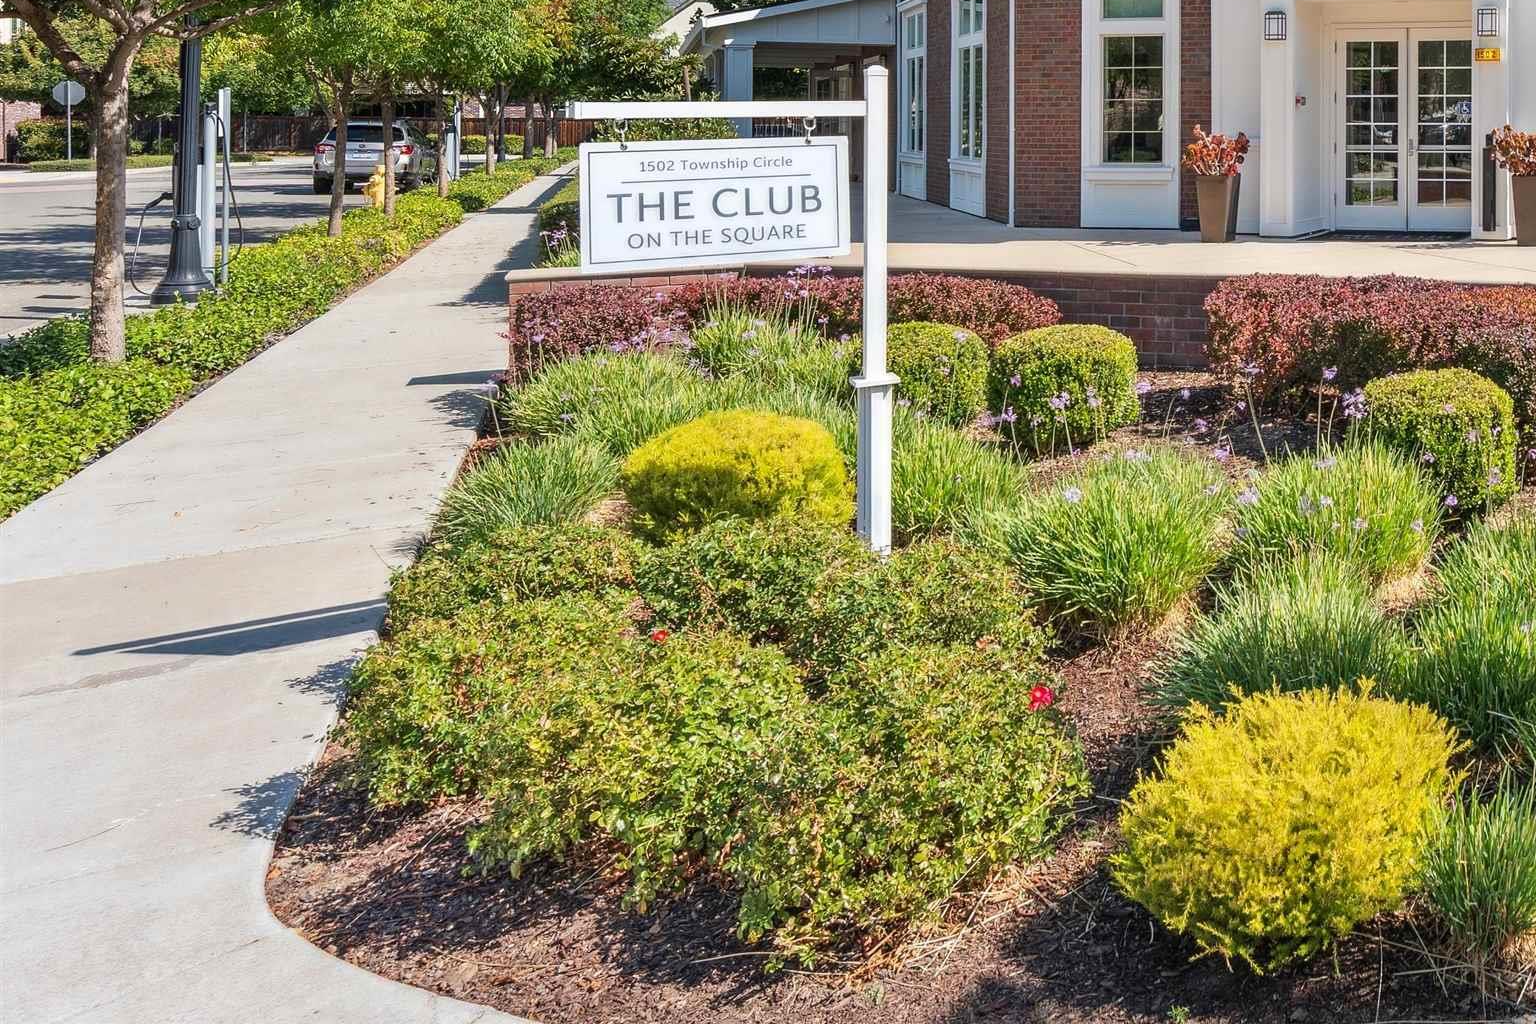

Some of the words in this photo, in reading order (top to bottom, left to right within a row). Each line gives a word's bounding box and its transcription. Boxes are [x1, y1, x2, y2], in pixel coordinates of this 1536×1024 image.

[1477, 50, 1497, 58] 1502
[640, 160, 674, 172] 1502
[680, 157, 748, 172] Township
[753, 156, 793, 168] Circle
[606, 190, 695, 223] THE
[712, 184, 823, 218] CLUB
[627, 232, 661, 249] ON
[670, 229, 713, 247] THE
[721, 223, 808, 245] SQUARE
